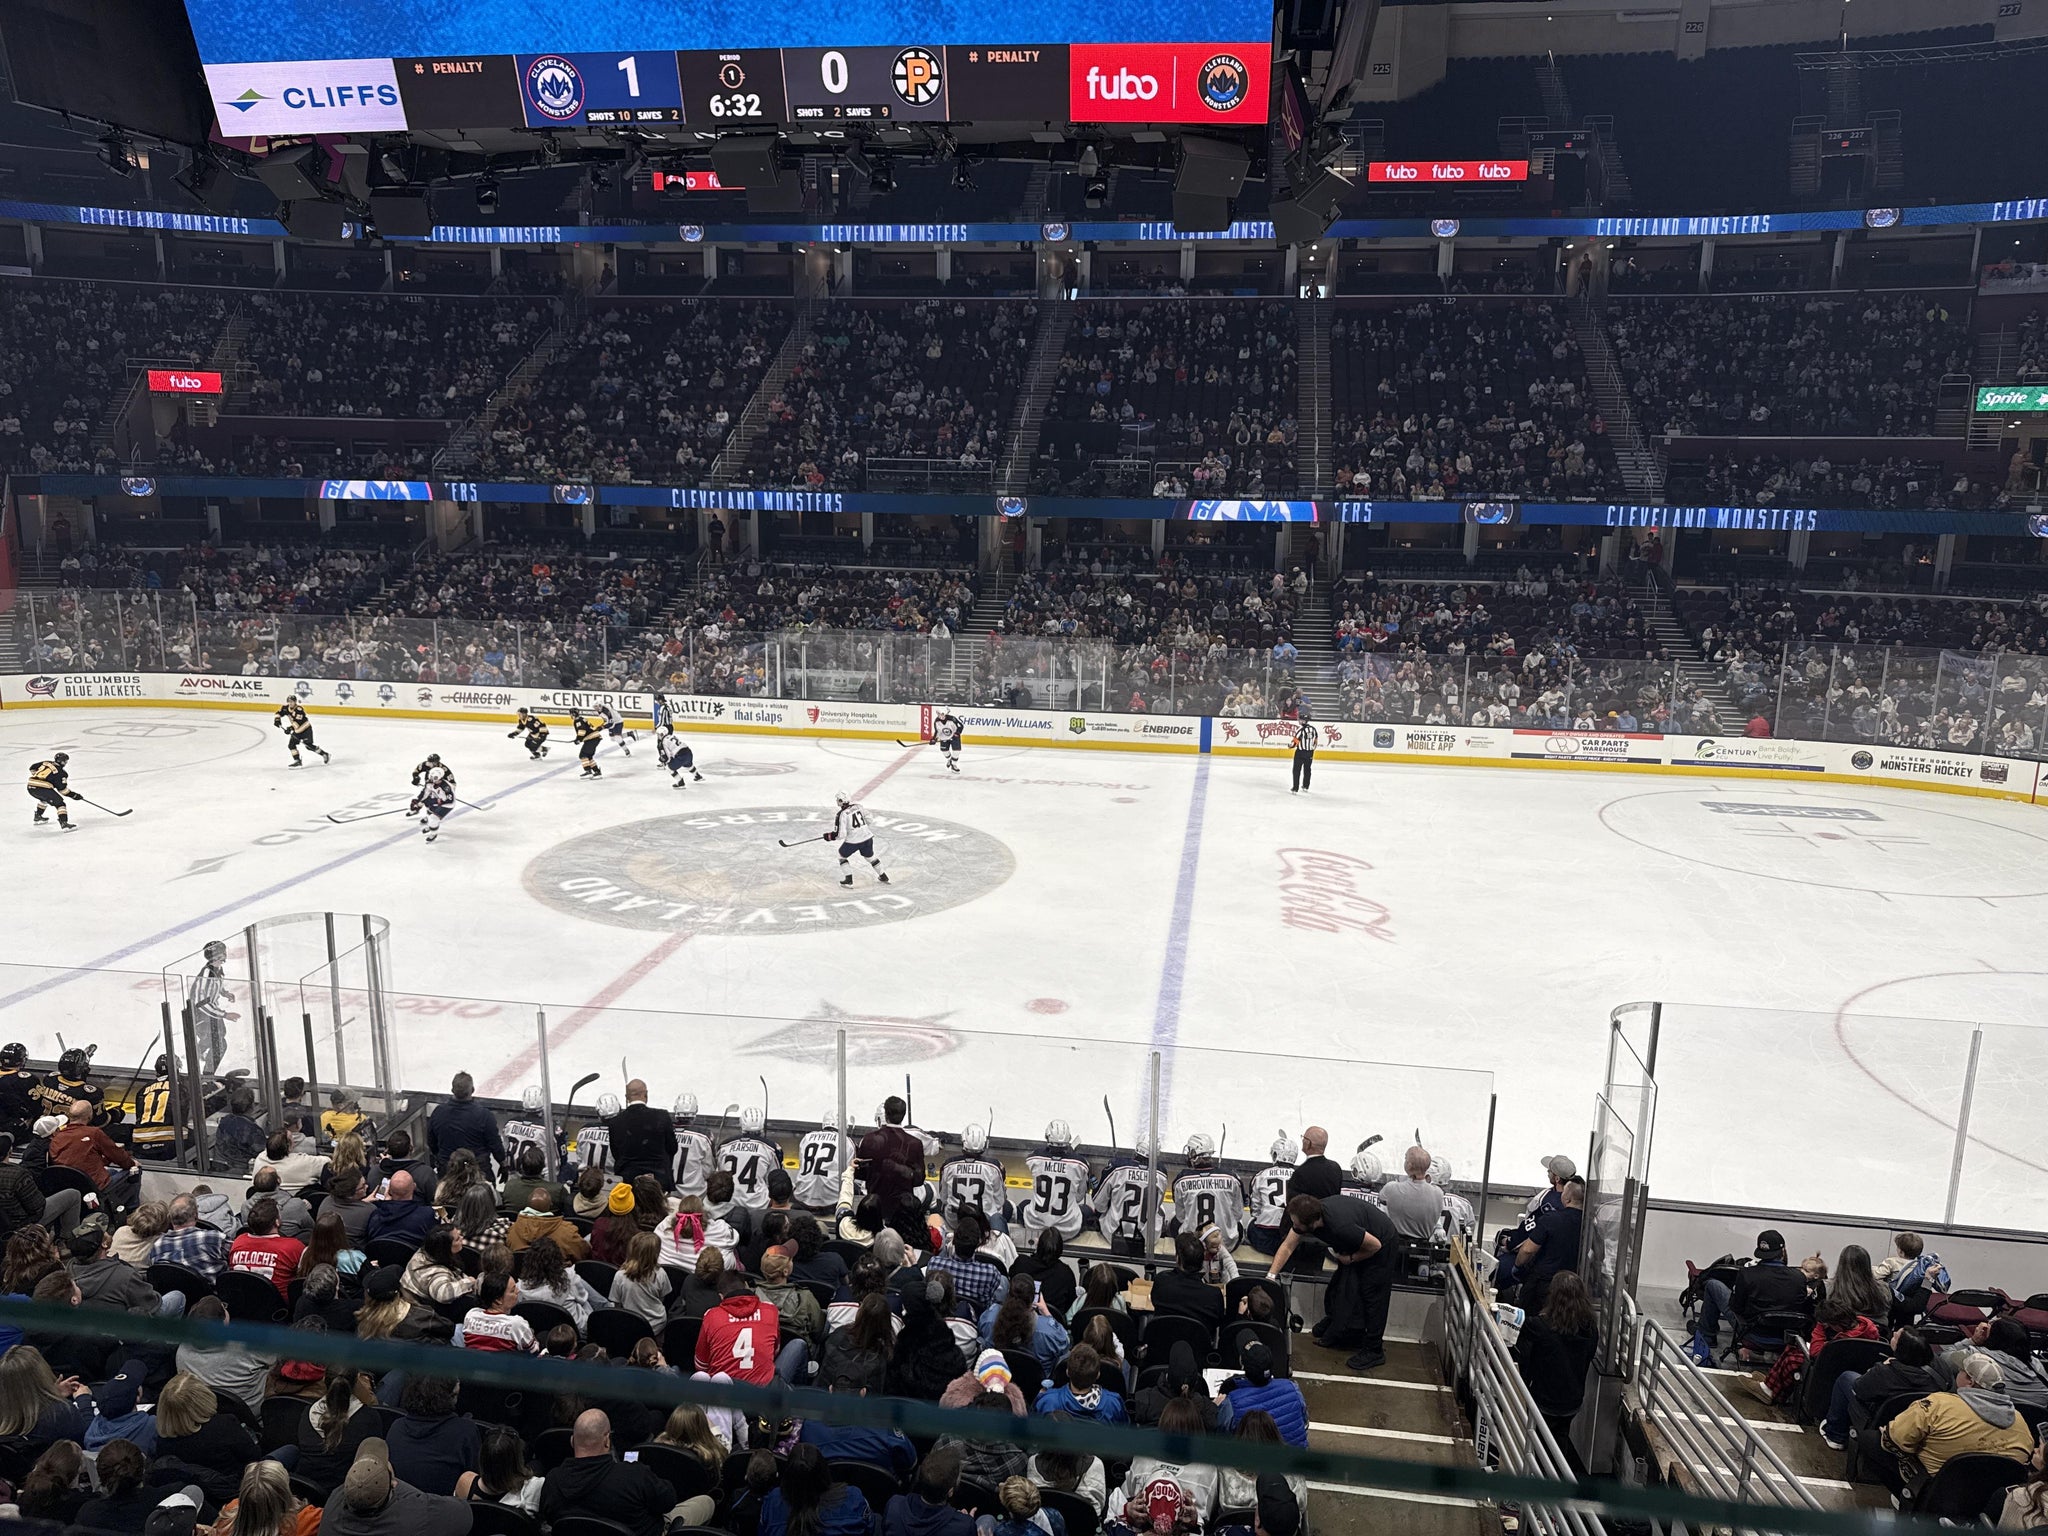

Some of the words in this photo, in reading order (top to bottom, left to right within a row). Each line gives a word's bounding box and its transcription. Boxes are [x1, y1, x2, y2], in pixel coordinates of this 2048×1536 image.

[1686, 23, 1704, 32] 226
[718, 53, 741, 61] PERIOD
[987, 50, 1040, 63] PENALTY
[432, 61, 484, 75] PENALTY
[530, 59, 576, 79] CLEVELAND
[820, 50, 849, 94] 0
[1203, 56, 1243, 73] CLEVELAND
[1373, 64, 1391, 74] 225
[618, 56, 641, 98] 1
[728, 69, 736, 81] 1
[1086, 66, 1158, 100] fubo
[283, 84, 398, 109] CLIFFS
[1204, 95, 1241, 110] MONSTERS
[536, 98, 580, 117] MONSTERS
[709, 93, 762, 117] 6:32
[796, 107, 824, 118] SHOTS
[833, 106, 841, 118] 2
[845, 107, 872, 117] SAVES
[881, 106, 889, 118] 9
[587, 111, 615, 122] SHOTS
[618, 110, 631, 121] 10
[636, 110, 663, 121] SAVES
[671, 109, 680, 120] 2
[1385, 164, 1418, 179] fubo
[1432, 164, 1464, 179] fubo
[1479, 163, 1511, 178] fubo
[79, 206, 163, 229] CLEVELAND
[172, 214, 249, 235] MONSTERS
[1596, 217, 1680, 237] CLEVELAND
[1688, 214, 1771, 236] MONSTERS
[424, 225, 493, 243] LEVELAND
[499, 226, 561, 244] MONSTERS
[822, 224, 895, 243] CLEVELAND
[900, 224, 967, 243] MONSTERS
[169, 374, 201, 388] fubo
[1981, 391, 2028, 406] Sprite
[672, 488, 755, 511] CLEVELAND
[763, 491, 843, 513] MONSTERS
[1606, 505, 1706, 529] CLEVELAND
[1717, 507, 1817, 532] MONSTERS
[64, 675, 141, 685] COLUMBUS
[65, 684, 92, 697] BLUE
[97, 684, 142, 697] JACKETS
[452, 691, 494, 705] CHARGE
[495, 693, 512, 706] ON
[618, 695, 642, 710] ICE
[734, 709, 753, 721] that
[755, 709, 783, 725] slaps
[1070, 717, 1085, 728] 811
[1142, 724, 1195, 735] ENBRIDGE
[1406, 733, 1456, 742] MONSTERS
[1601, 740, 1630, 748] PARTS
[1407, 741, 1436, 751] MOBILE
[1437, 742, 1454, 751] APP
[1582, 745, 1628, 753] WAREHOUSE
[1715, 748, 1758, 757] CENTURY
[1880, 760, 1932, 774] MONSTERS
[1934, 765, 1974, 778] HOCKEY
[683, 809, 962, 844] MONTERS
[140, 1091, 170, 1124] 11
[510, 1123, 537, 1139] DUMAIS
[729, 1140, 760, 1154] PEARSON
[800, 1142, 837, 1177] 82
[956, 1163, 983, 1176] PINELLI
[952, 1177, 985, 1208] 53
[1035, 1174, 1072, 1217] 93
[1197, 1192, 1216, 1224] 8
[232, 1250, 278, 1267] MELOCHE
[731, 1327, 755, 1370] 4
[1160, 1463, 1180, 1472] CCM
